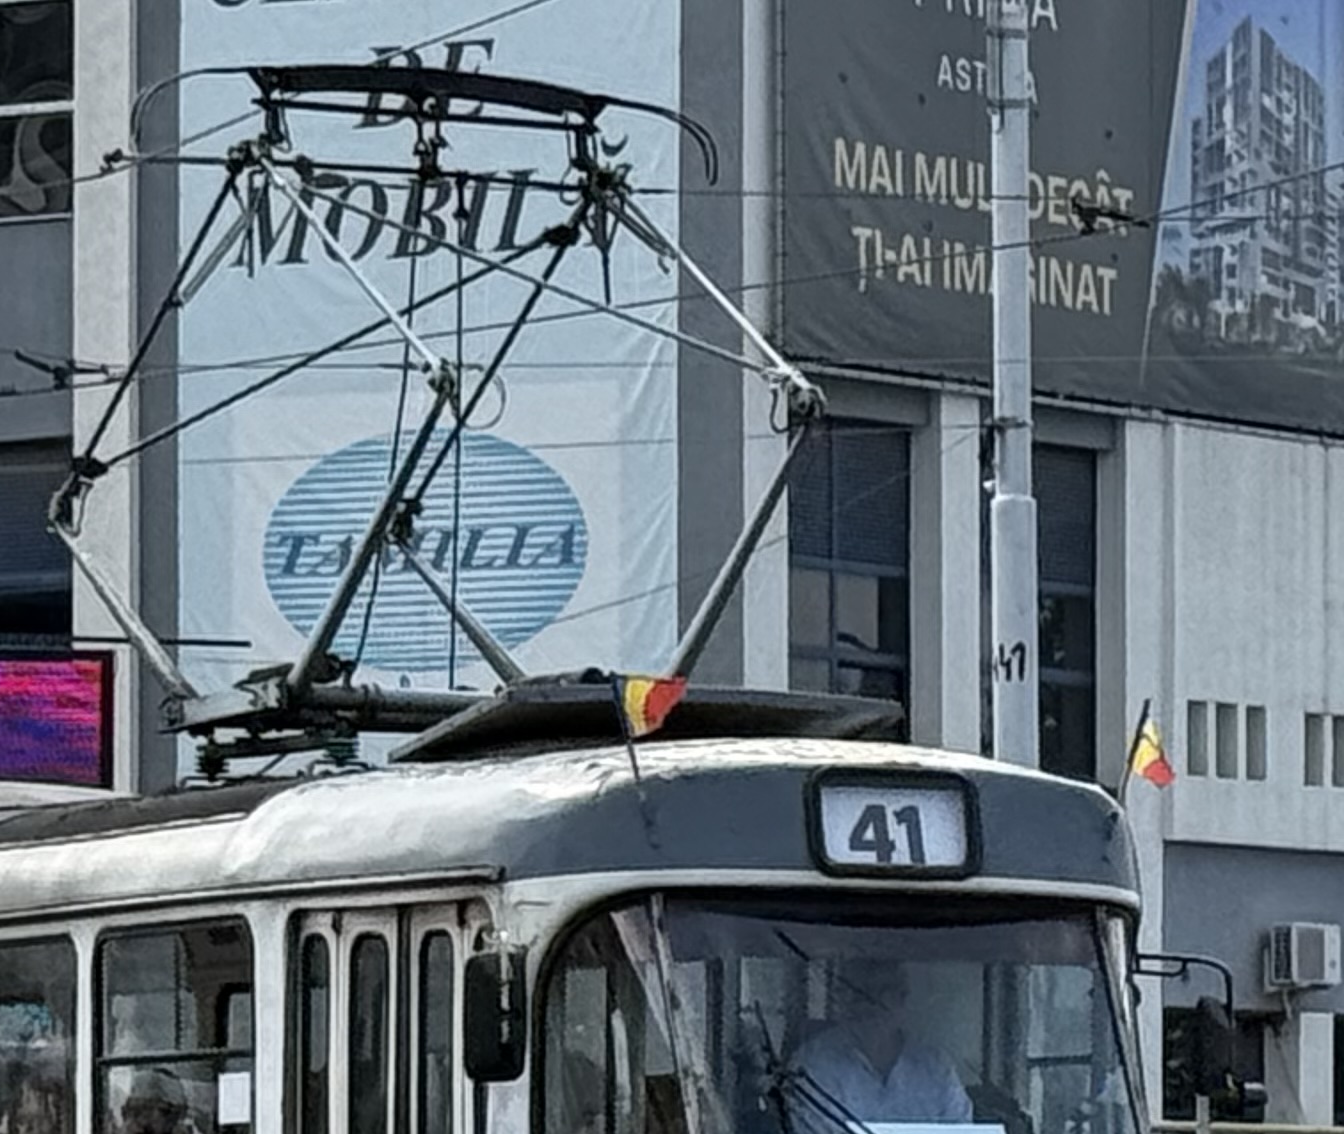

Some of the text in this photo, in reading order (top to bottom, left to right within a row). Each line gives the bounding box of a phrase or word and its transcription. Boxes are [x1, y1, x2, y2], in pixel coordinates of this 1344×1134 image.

[937, 54, 1038, 104] ASTA
[834, 138, 902, 196] MAI
[914, 152, 996, 210] MUL
[942, 239, 1118, 315] IMINAT
[849, 804, 926, 864] 41
